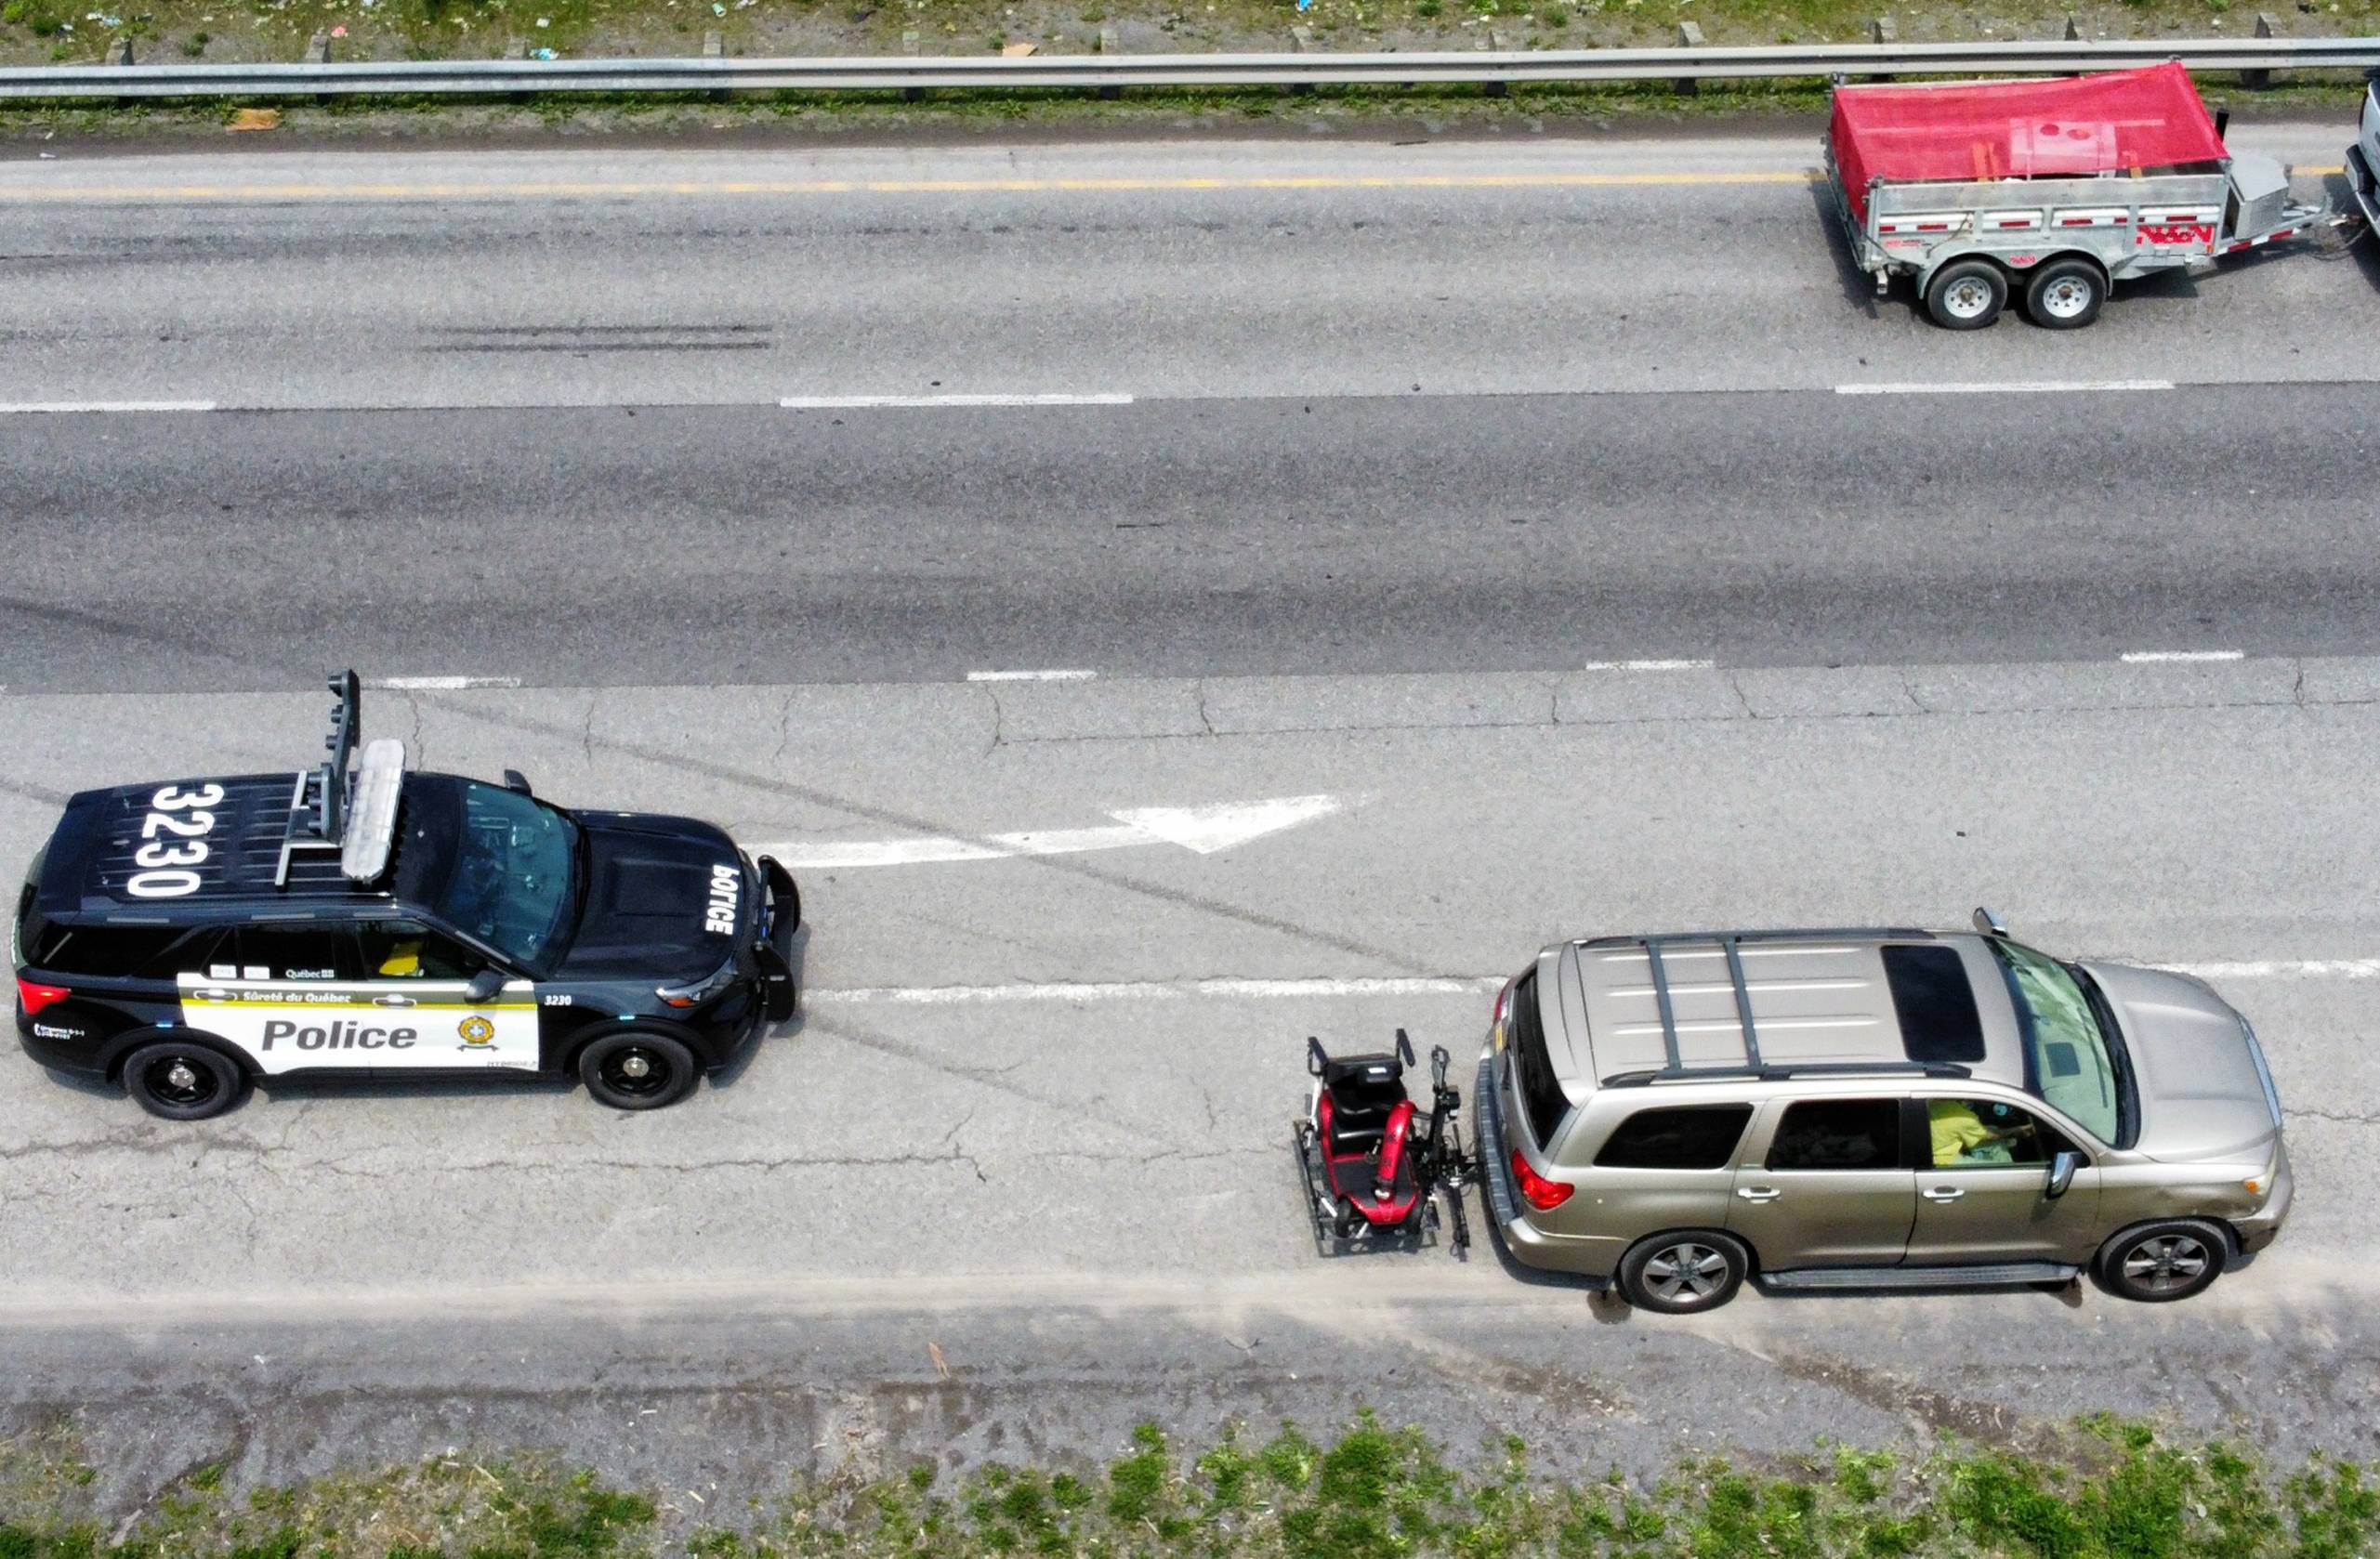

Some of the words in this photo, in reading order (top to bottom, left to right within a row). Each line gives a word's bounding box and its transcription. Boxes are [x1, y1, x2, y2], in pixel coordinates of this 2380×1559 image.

[127, 784, 225, 897] 3230
[285, 968, 321, 979] Québec
[243, 990, 283, 1002] Sûreté
[285, 992, 303, 1002] du
[305, 991, 351, 1003] Québec
[544, 994, 572, 1006] 3230
[262, 1019, 418, 1052] Police
